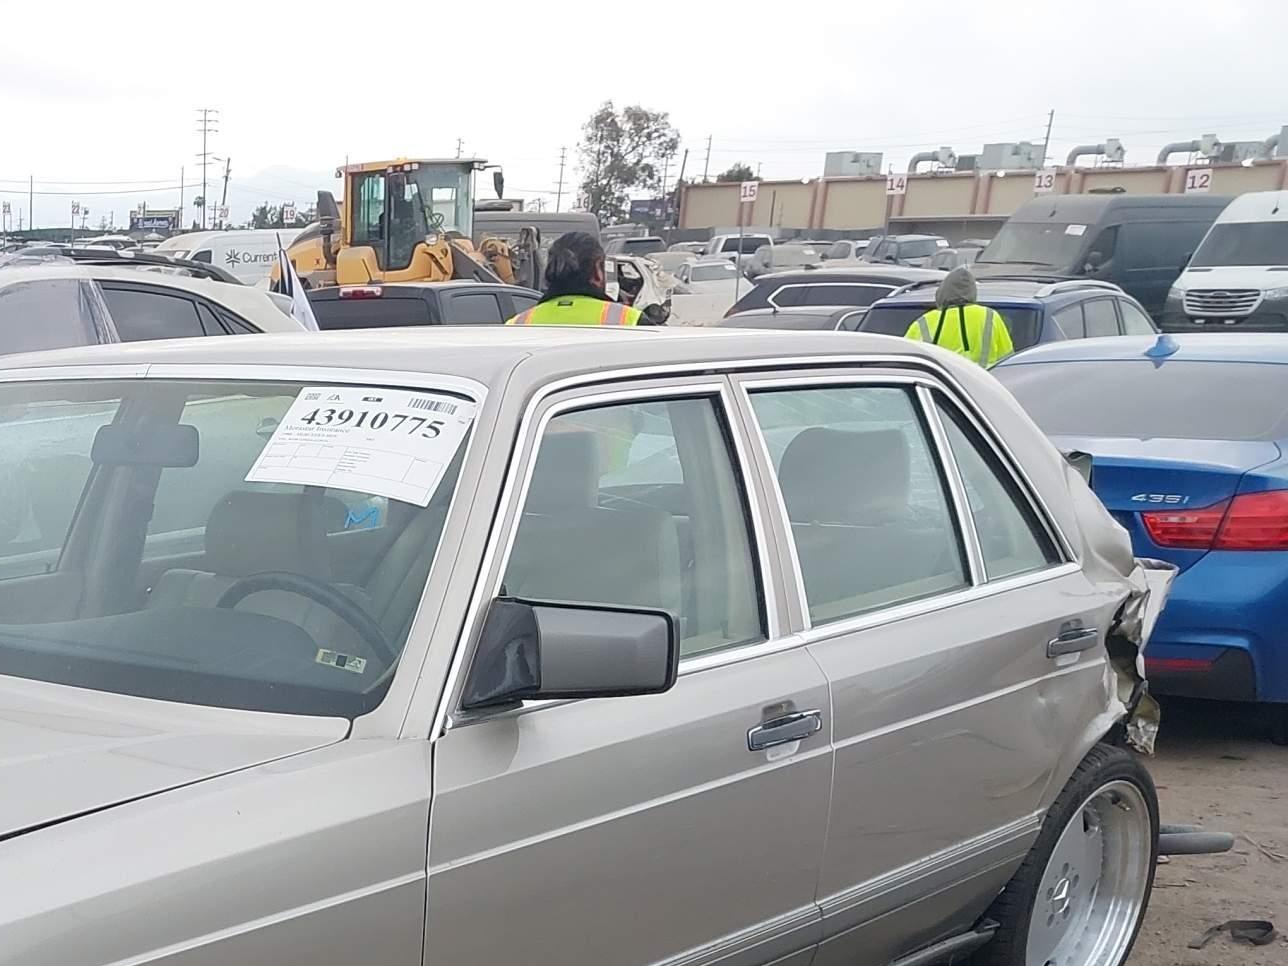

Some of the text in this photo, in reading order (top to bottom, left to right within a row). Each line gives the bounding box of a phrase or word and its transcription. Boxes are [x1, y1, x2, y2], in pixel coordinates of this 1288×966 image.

[887, 178, 905, 191] 14
[1035, 174, 1054, 188] 13
[1187, 174, 1210, 190] 12
[742, 185, 757, 198] 15
[284, 209, 296, 220] 19
[242, 251, 279, 264] Current
[301, 407, 446, 440] 43910775
